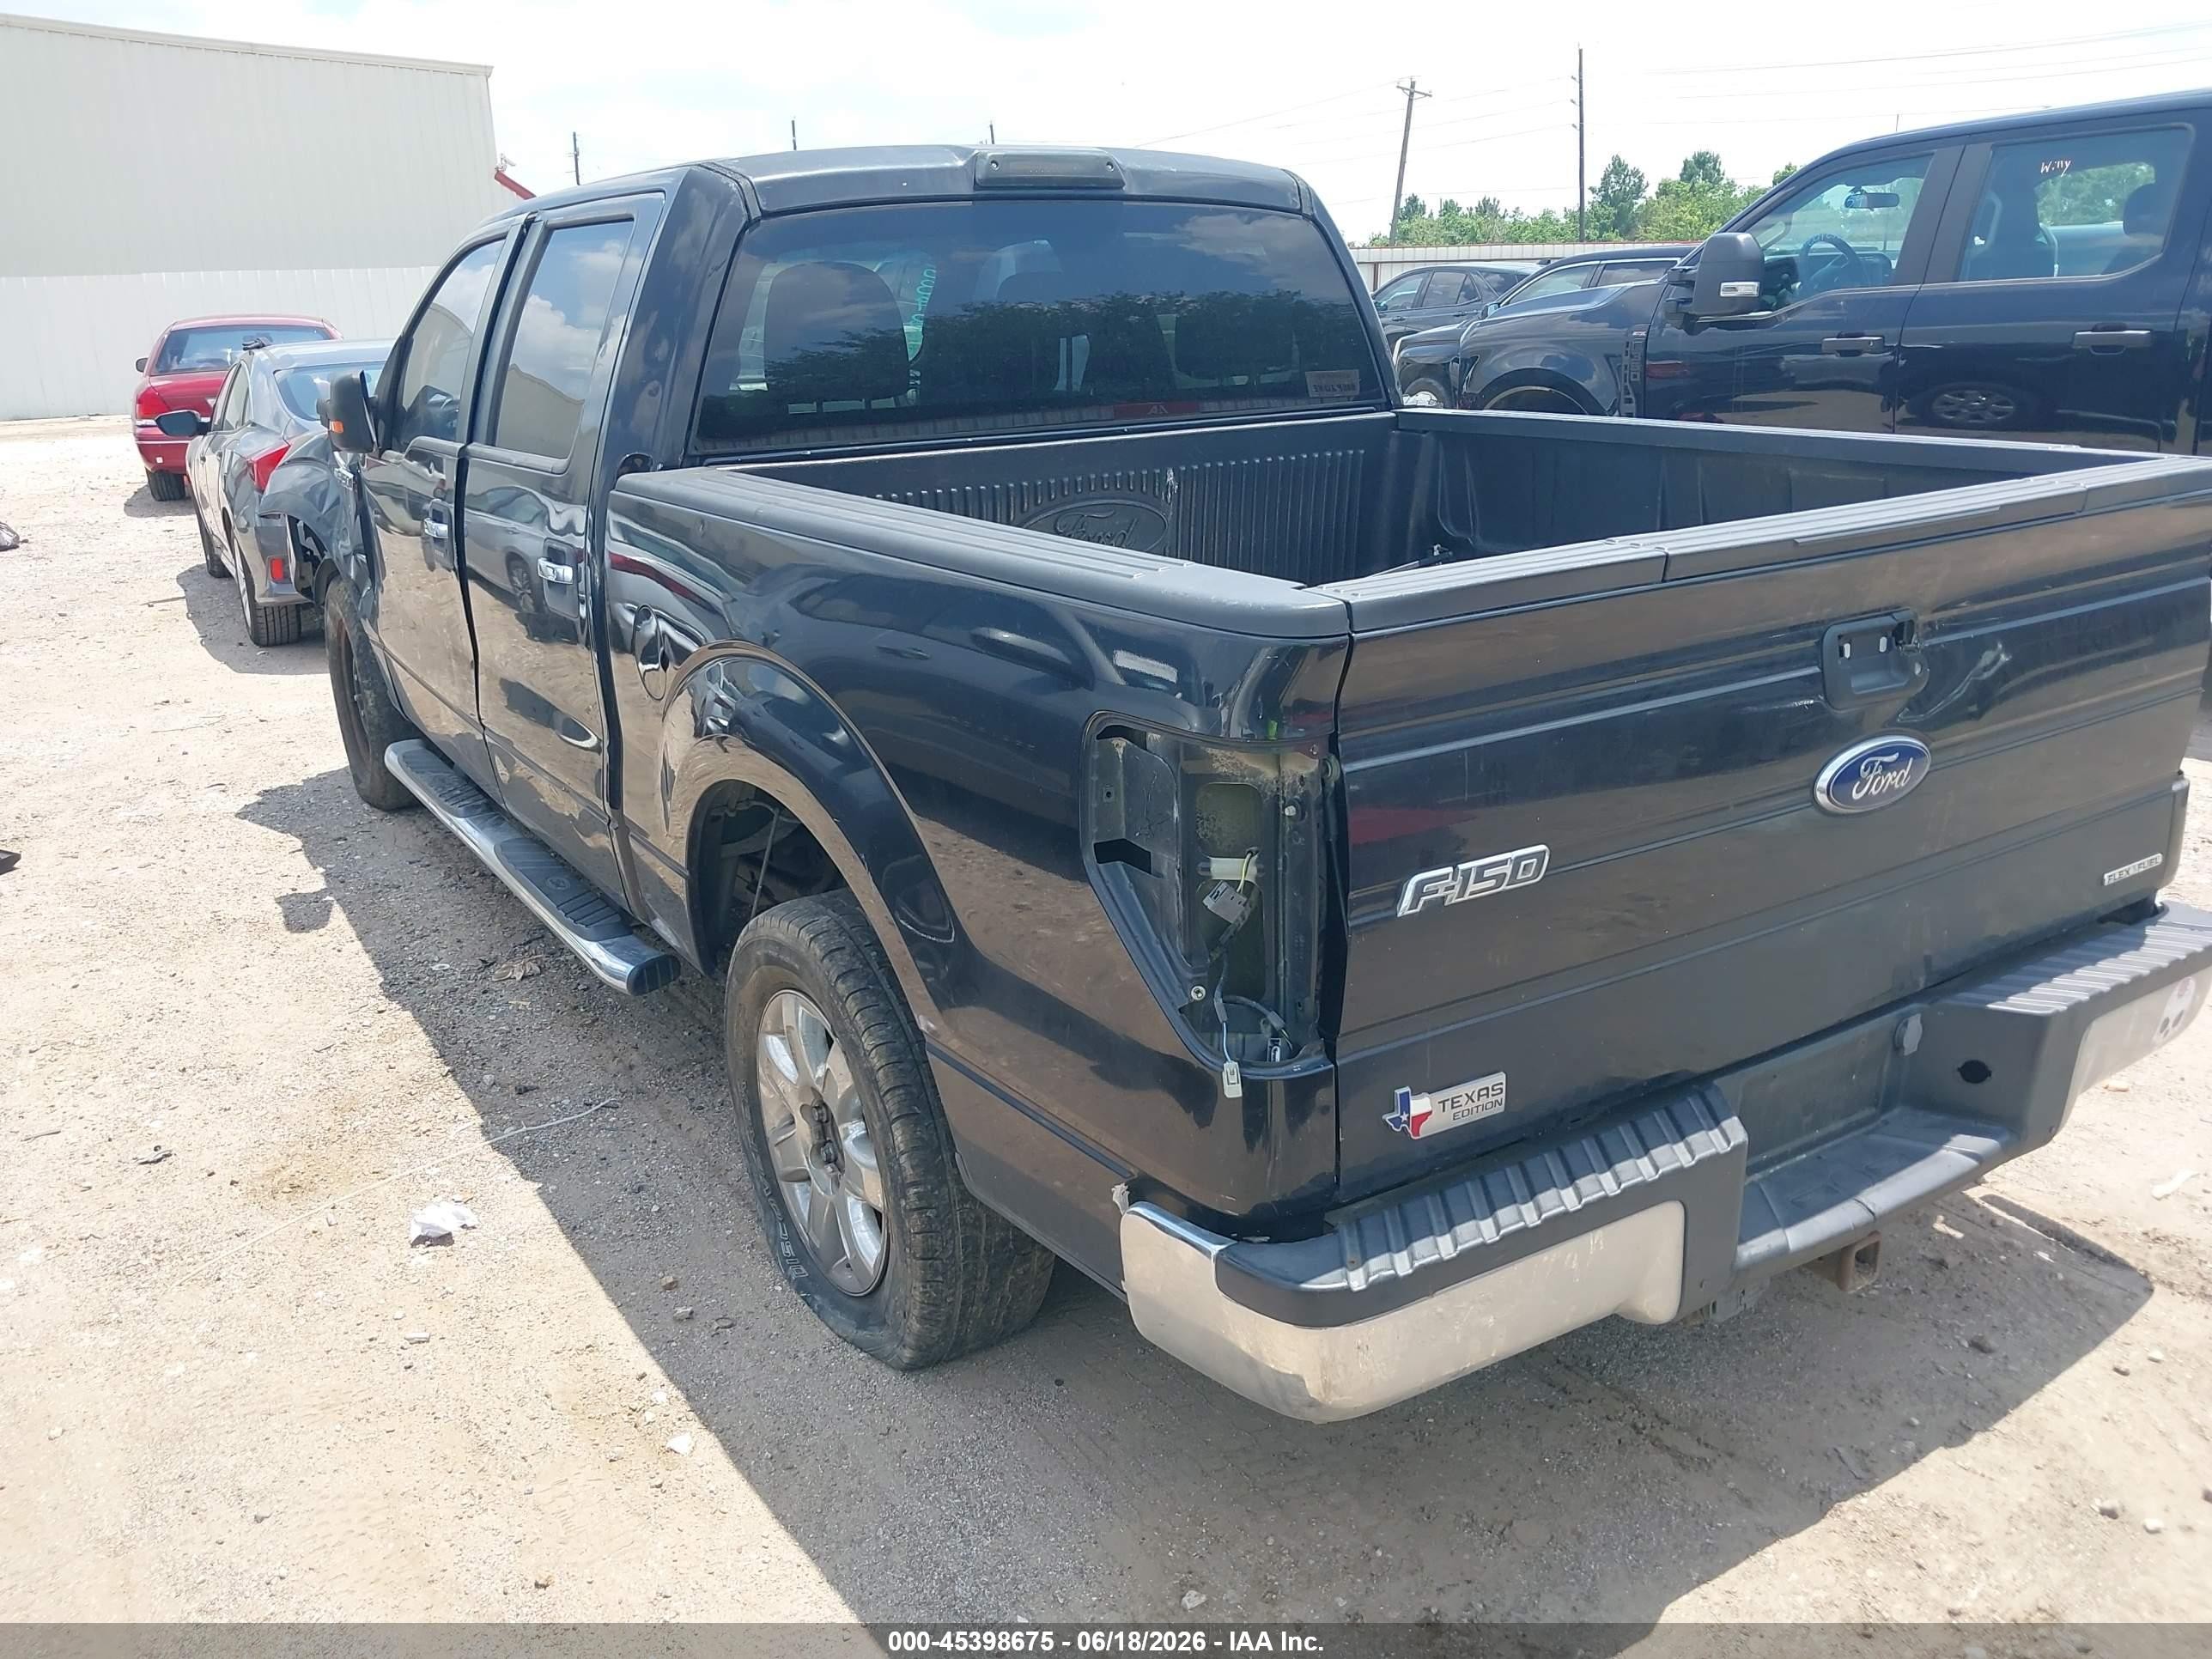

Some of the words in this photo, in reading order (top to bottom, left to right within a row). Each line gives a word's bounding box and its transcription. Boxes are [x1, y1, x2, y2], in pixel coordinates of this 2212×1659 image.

[1851, 752, 1914, 800] Ford
[1396, 844, 1551, 918] F-150
[2107, 867, 2131, 884] FLEX
[2137, 857, 2160, 872] FUEL
[1437, 1082, 1504, 1113] TEXAS
[1451, 1097, 1504, 1121] EDITION
